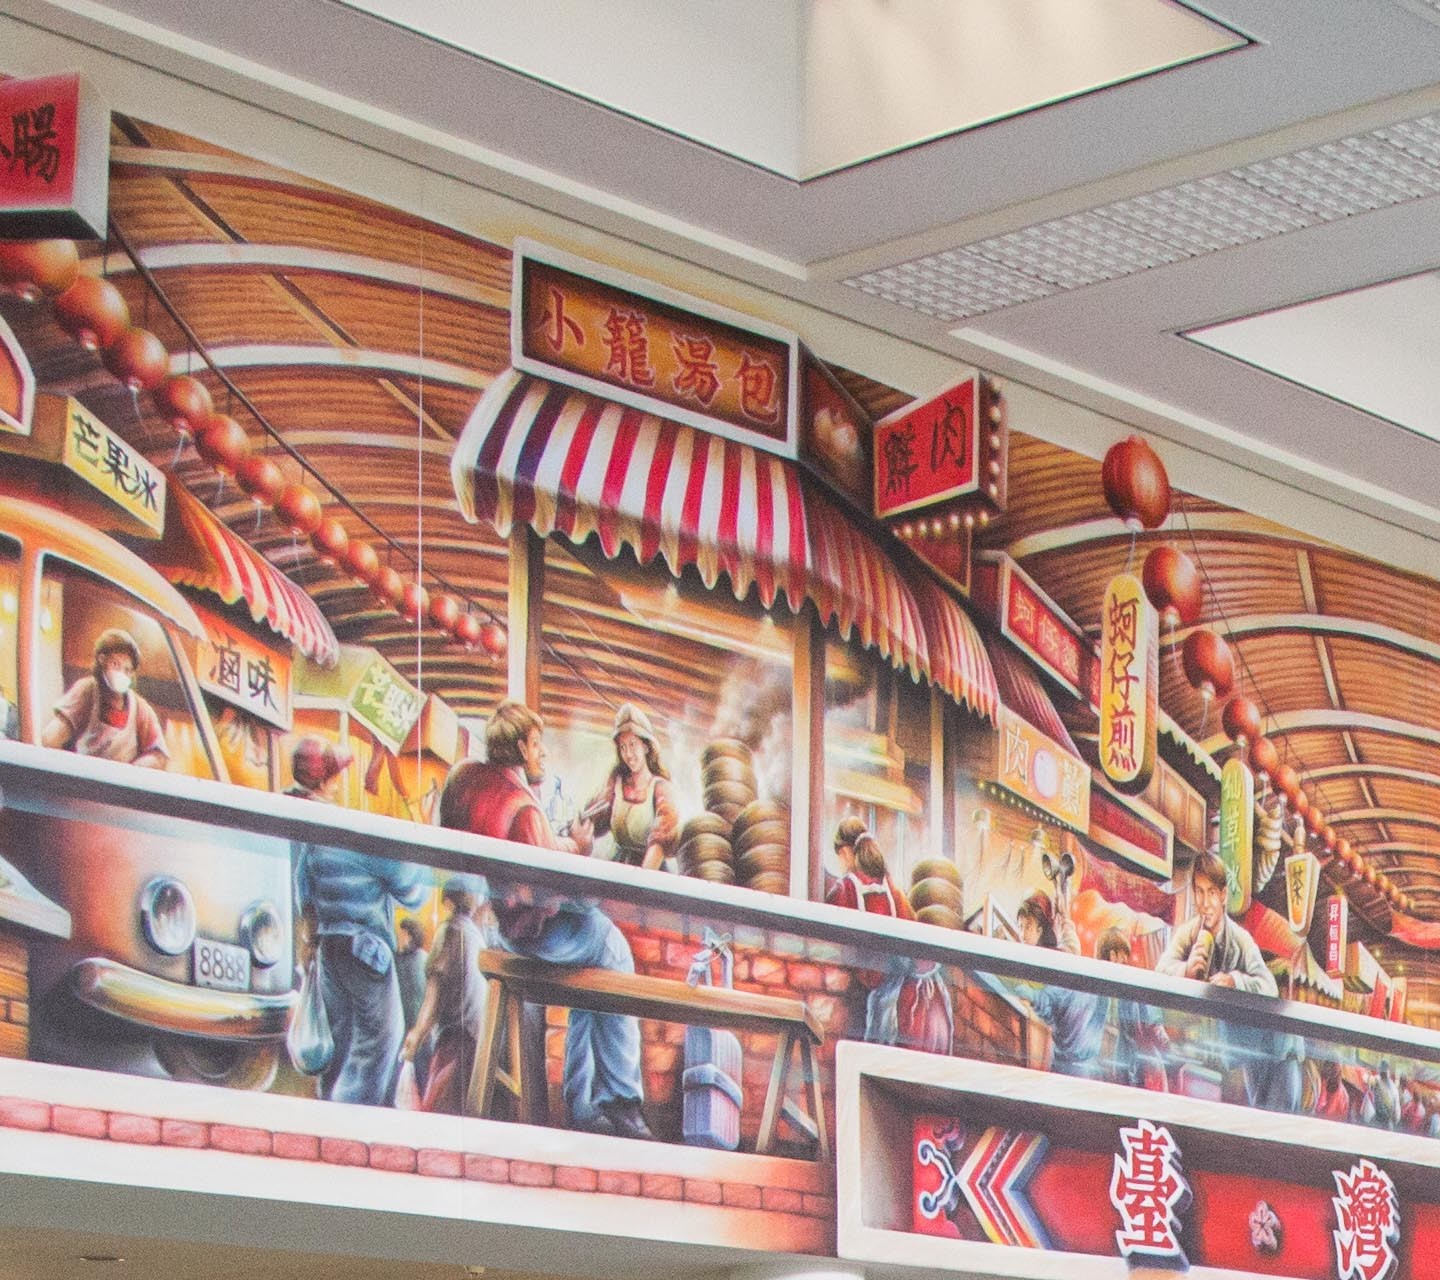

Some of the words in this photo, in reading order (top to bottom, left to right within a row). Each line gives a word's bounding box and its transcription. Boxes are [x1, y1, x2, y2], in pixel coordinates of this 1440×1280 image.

[532, 284, 779, 425] 小籠湯包
[71, 413, 159, 514] 芒果冰
[211, 632, 278, 707] 滷味
[1108, 593, 1140, 772] 蚵仔煎
[199, 943, 247, 985] 8888
